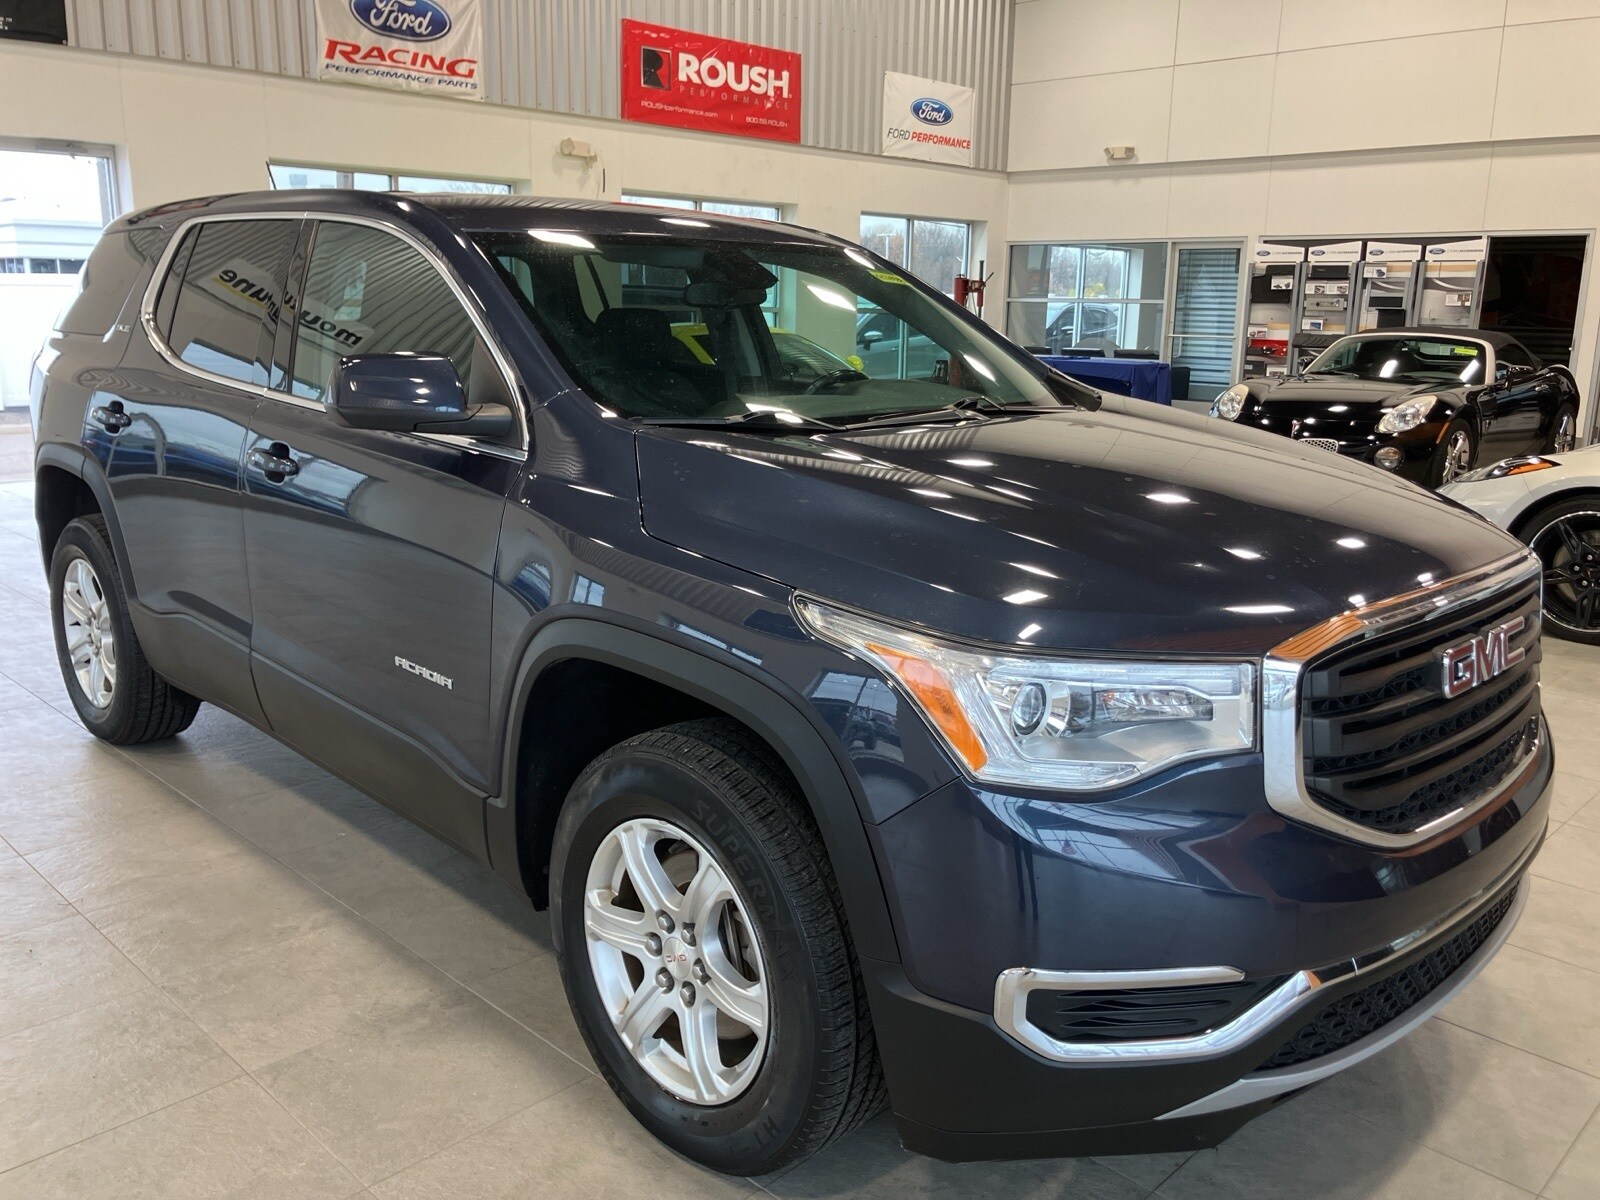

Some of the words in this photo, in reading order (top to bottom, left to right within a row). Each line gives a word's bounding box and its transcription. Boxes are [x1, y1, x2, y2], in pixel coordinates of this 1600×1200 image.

[369, 0, 432, 36] Ford
[325, 38, 477, 79] RACING
[677, 52, 790, 99] ROUSH
[324, 63, 434, 85] PERFORMANCE
[437, 79, 478, 90] PARTS
[679, 85, 789, 110] PERFORMANCE
[918, 101, 946, 122] Ford
[887, 127, 911, 141] FORD
[911, 131, 971, 150] PERFORMANCE
[394, 655, 454, 690] ACADIA
[1443, 615, 1525, 699] GMC
[690, 799, 796, 982] SUPERMAX
[666, 953, 687, 962] GMC
